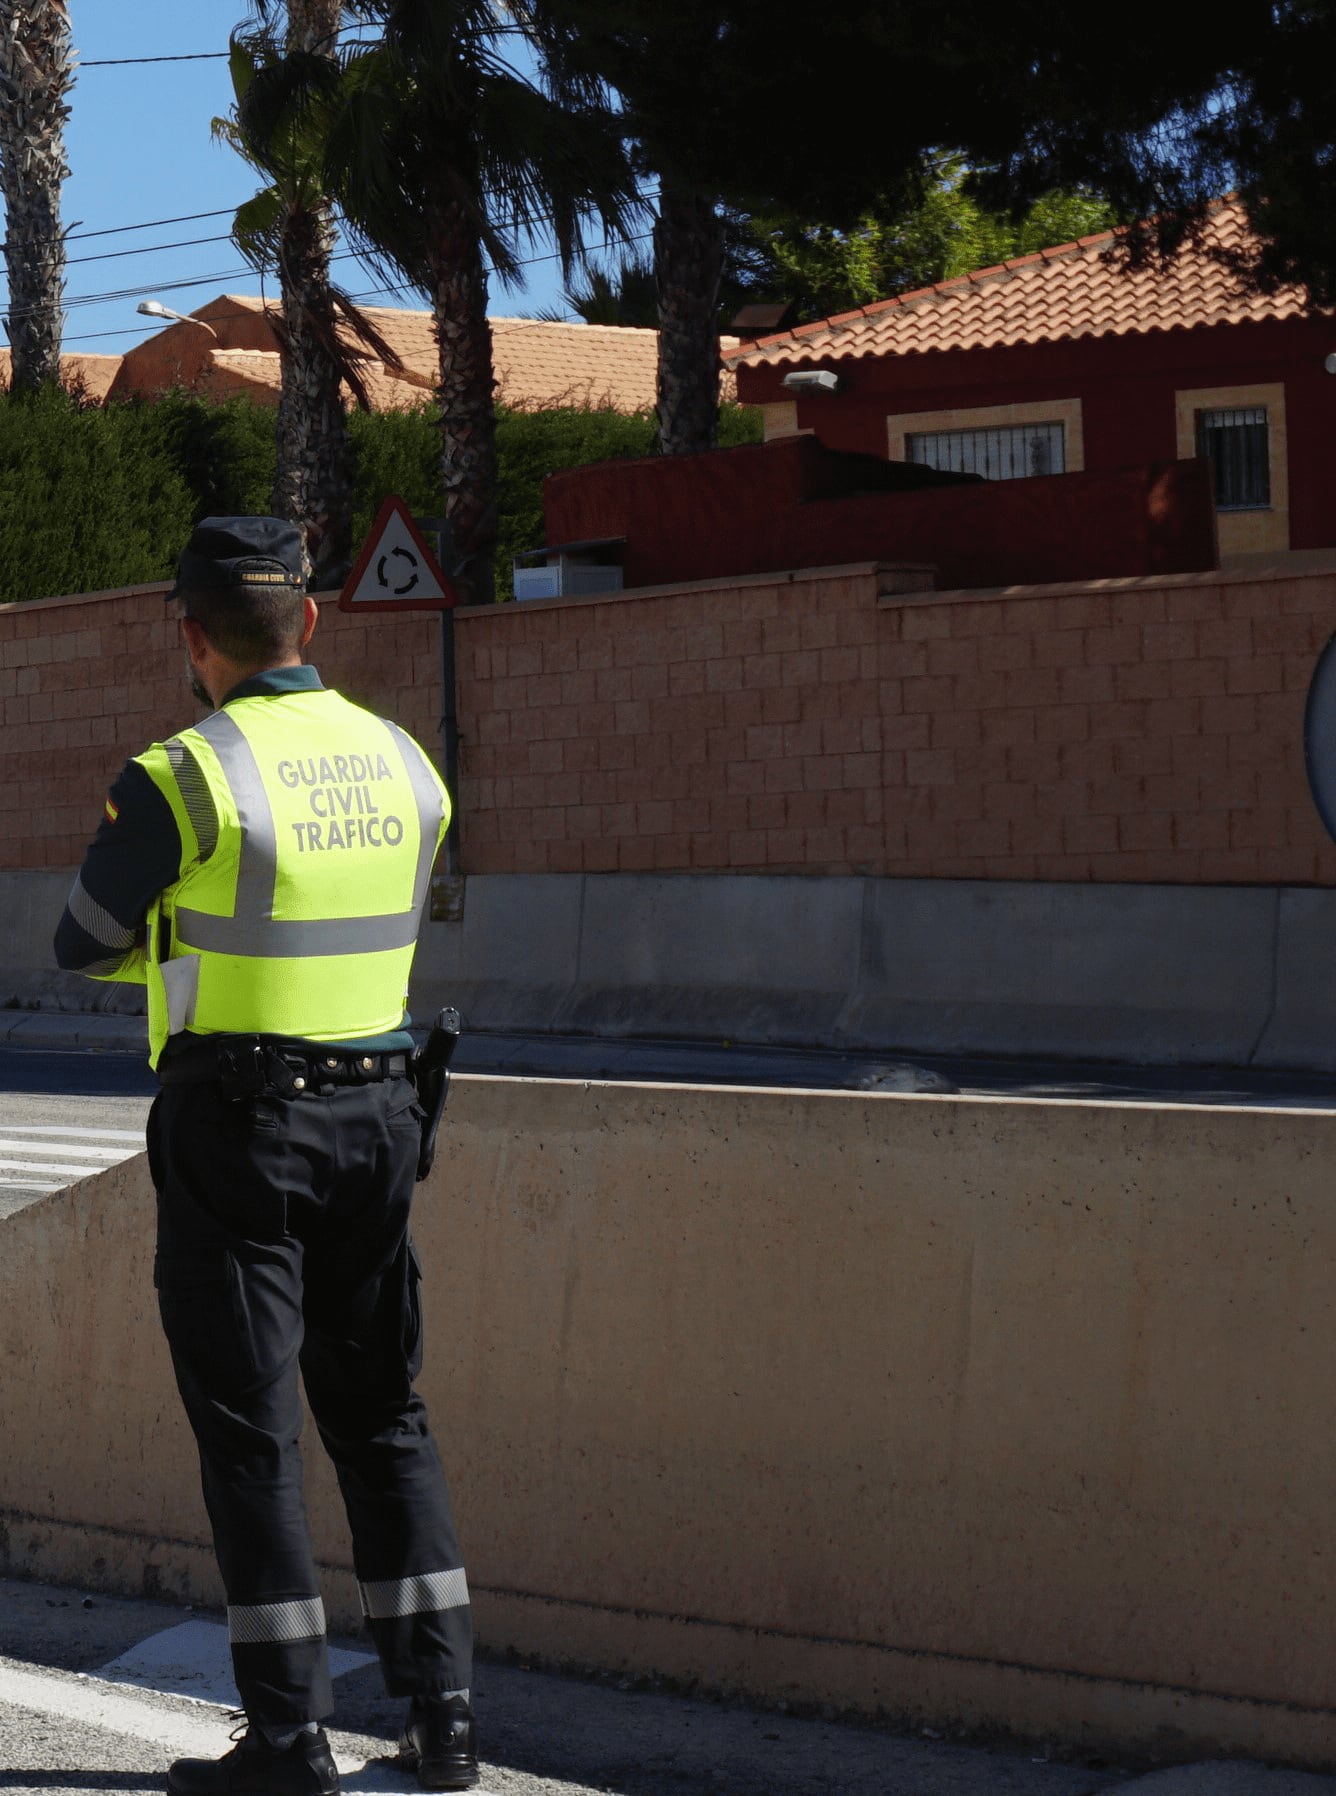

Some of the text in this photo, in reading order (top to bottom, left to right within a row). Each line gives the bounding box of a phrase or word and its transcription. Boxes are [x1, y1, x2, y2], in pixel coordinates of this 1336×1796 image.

[277, 753, 393, 788] GUARDIA
[309, 785, 378, 818] CIVIL
[292, 815, 403, 852] TRAFICO
